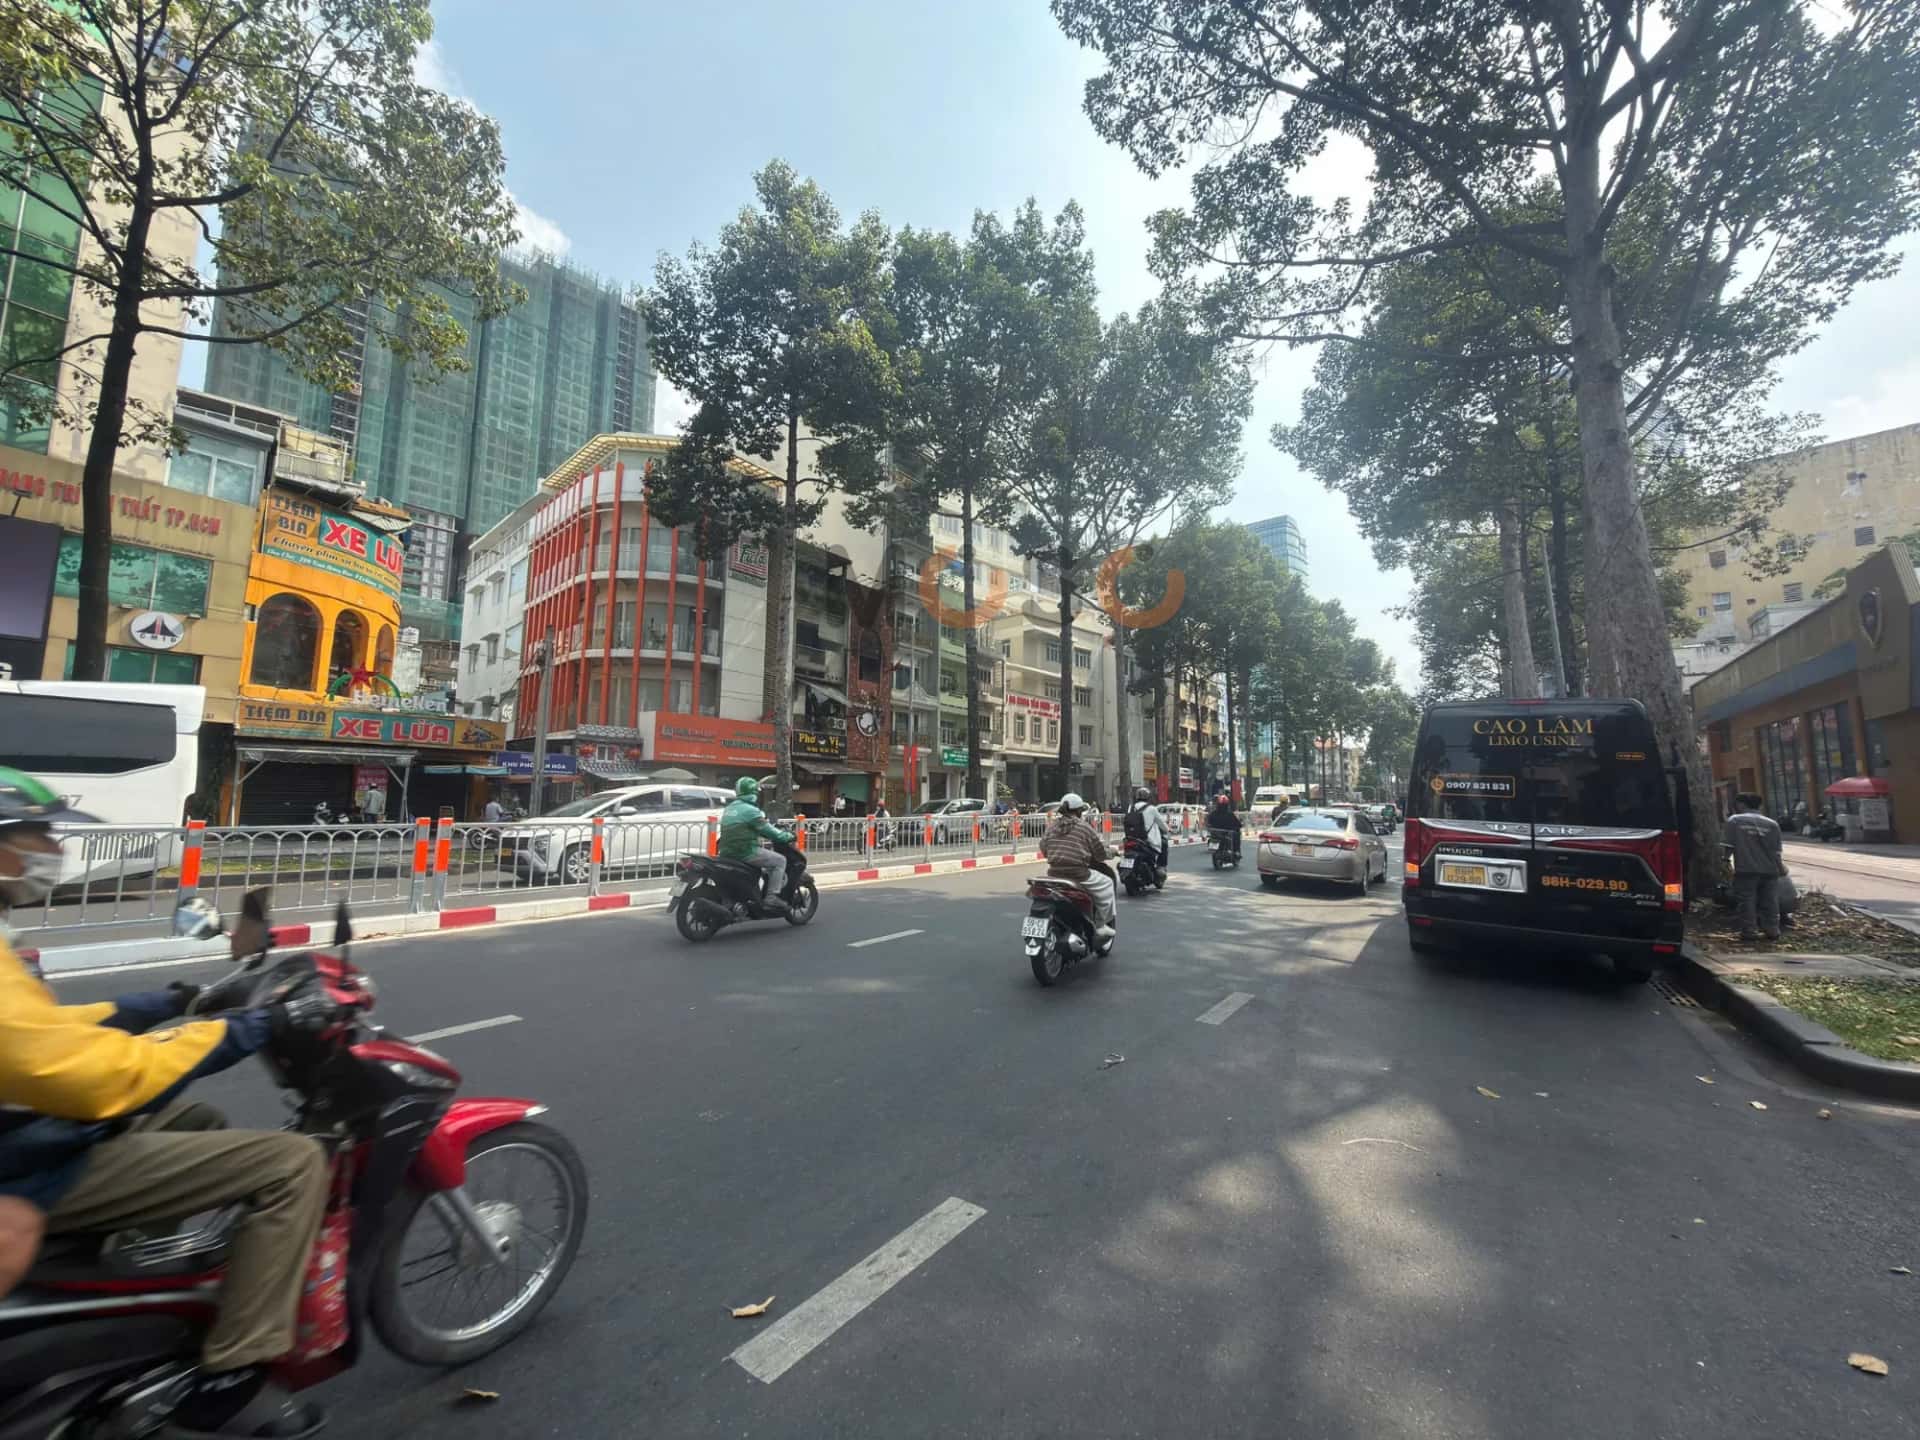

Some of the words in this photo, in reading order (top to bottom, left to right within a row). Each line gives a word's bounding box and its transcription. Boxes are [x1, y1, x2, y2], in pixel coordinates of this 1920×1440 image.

[278, 515, 308, 536] BIA
[323, 517, 368, 558] XE
[297, 709, 326, 723] BIA
[1473, 719, 1527, 735] CAO
[1536, 714, 1594, 735] LÂM
[336, 717, 383, 739] XE
[392, 718, 450, 744] LỬA
[1446, 781, 1471, 790] 0907
